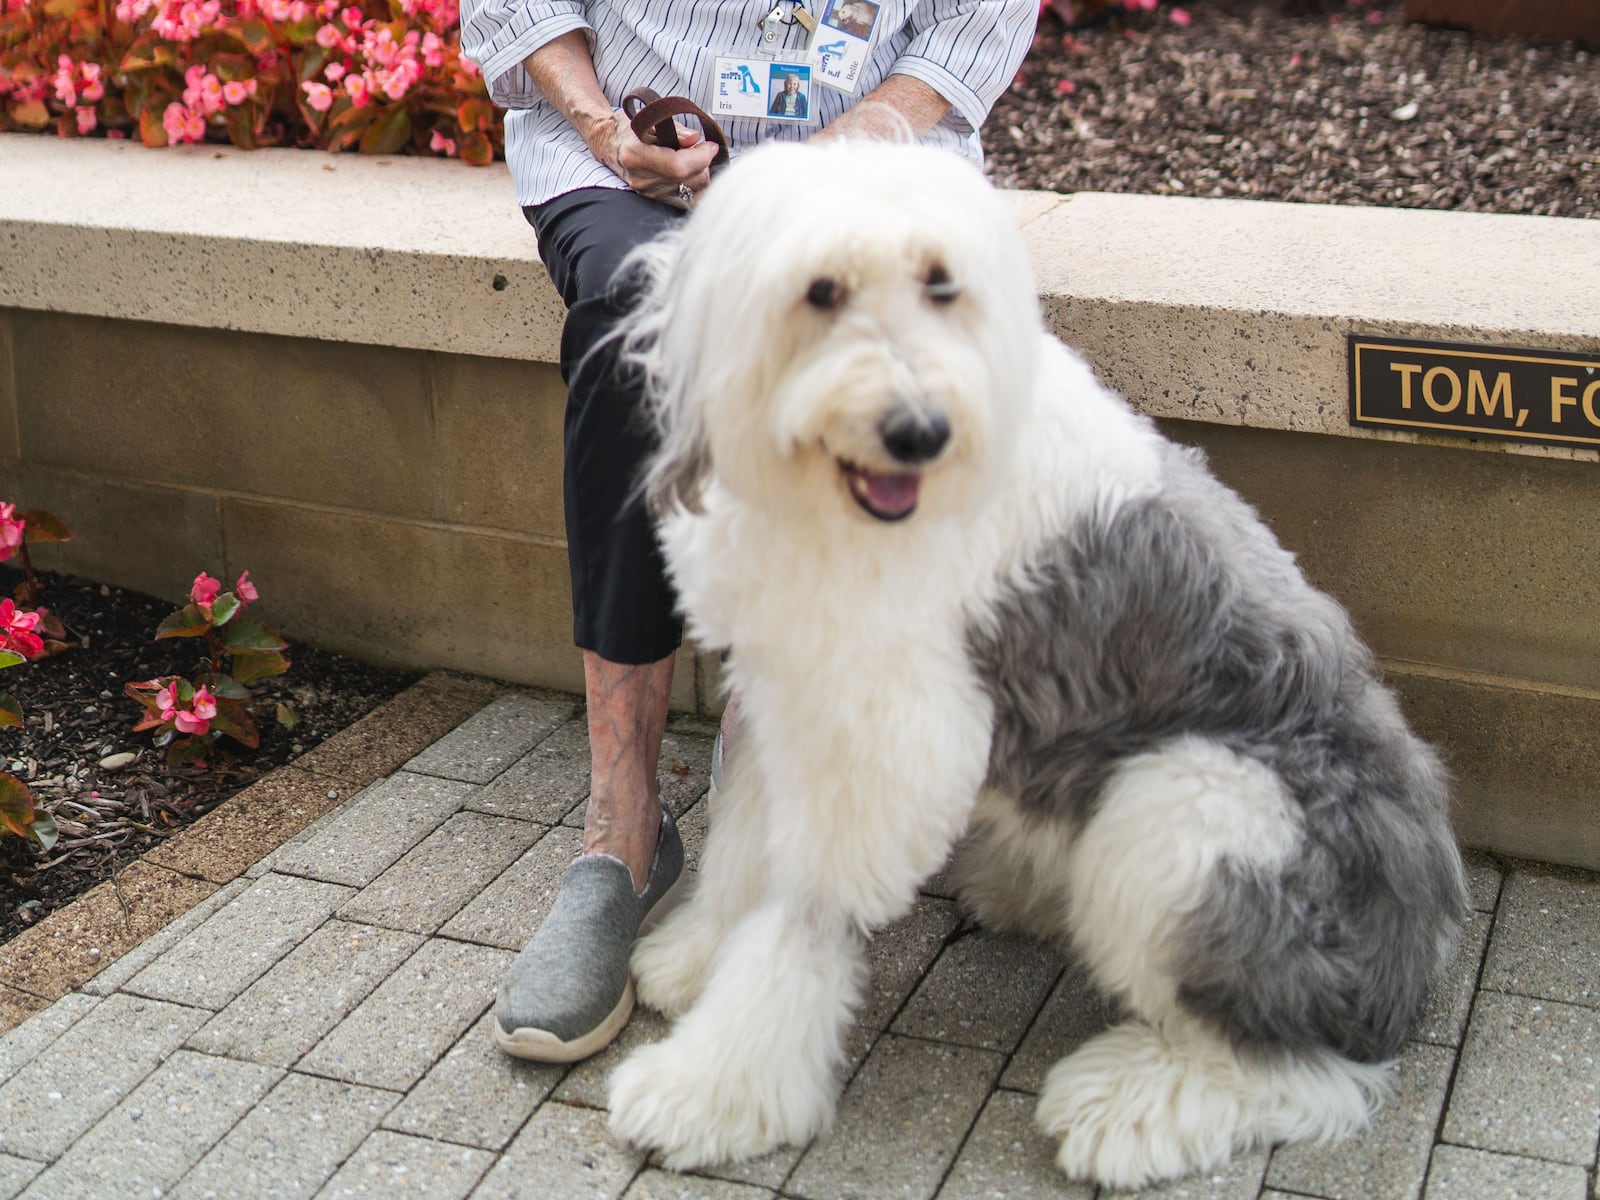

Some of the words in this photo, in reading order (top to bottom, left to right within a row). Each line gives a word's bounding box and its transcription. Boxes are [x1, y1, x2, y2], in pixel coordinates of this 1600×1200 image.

[846, 60, 860, 81] Belle
[719, 100, 733, 110] Iris
[1389, 362, 1529, 427] TOM,
